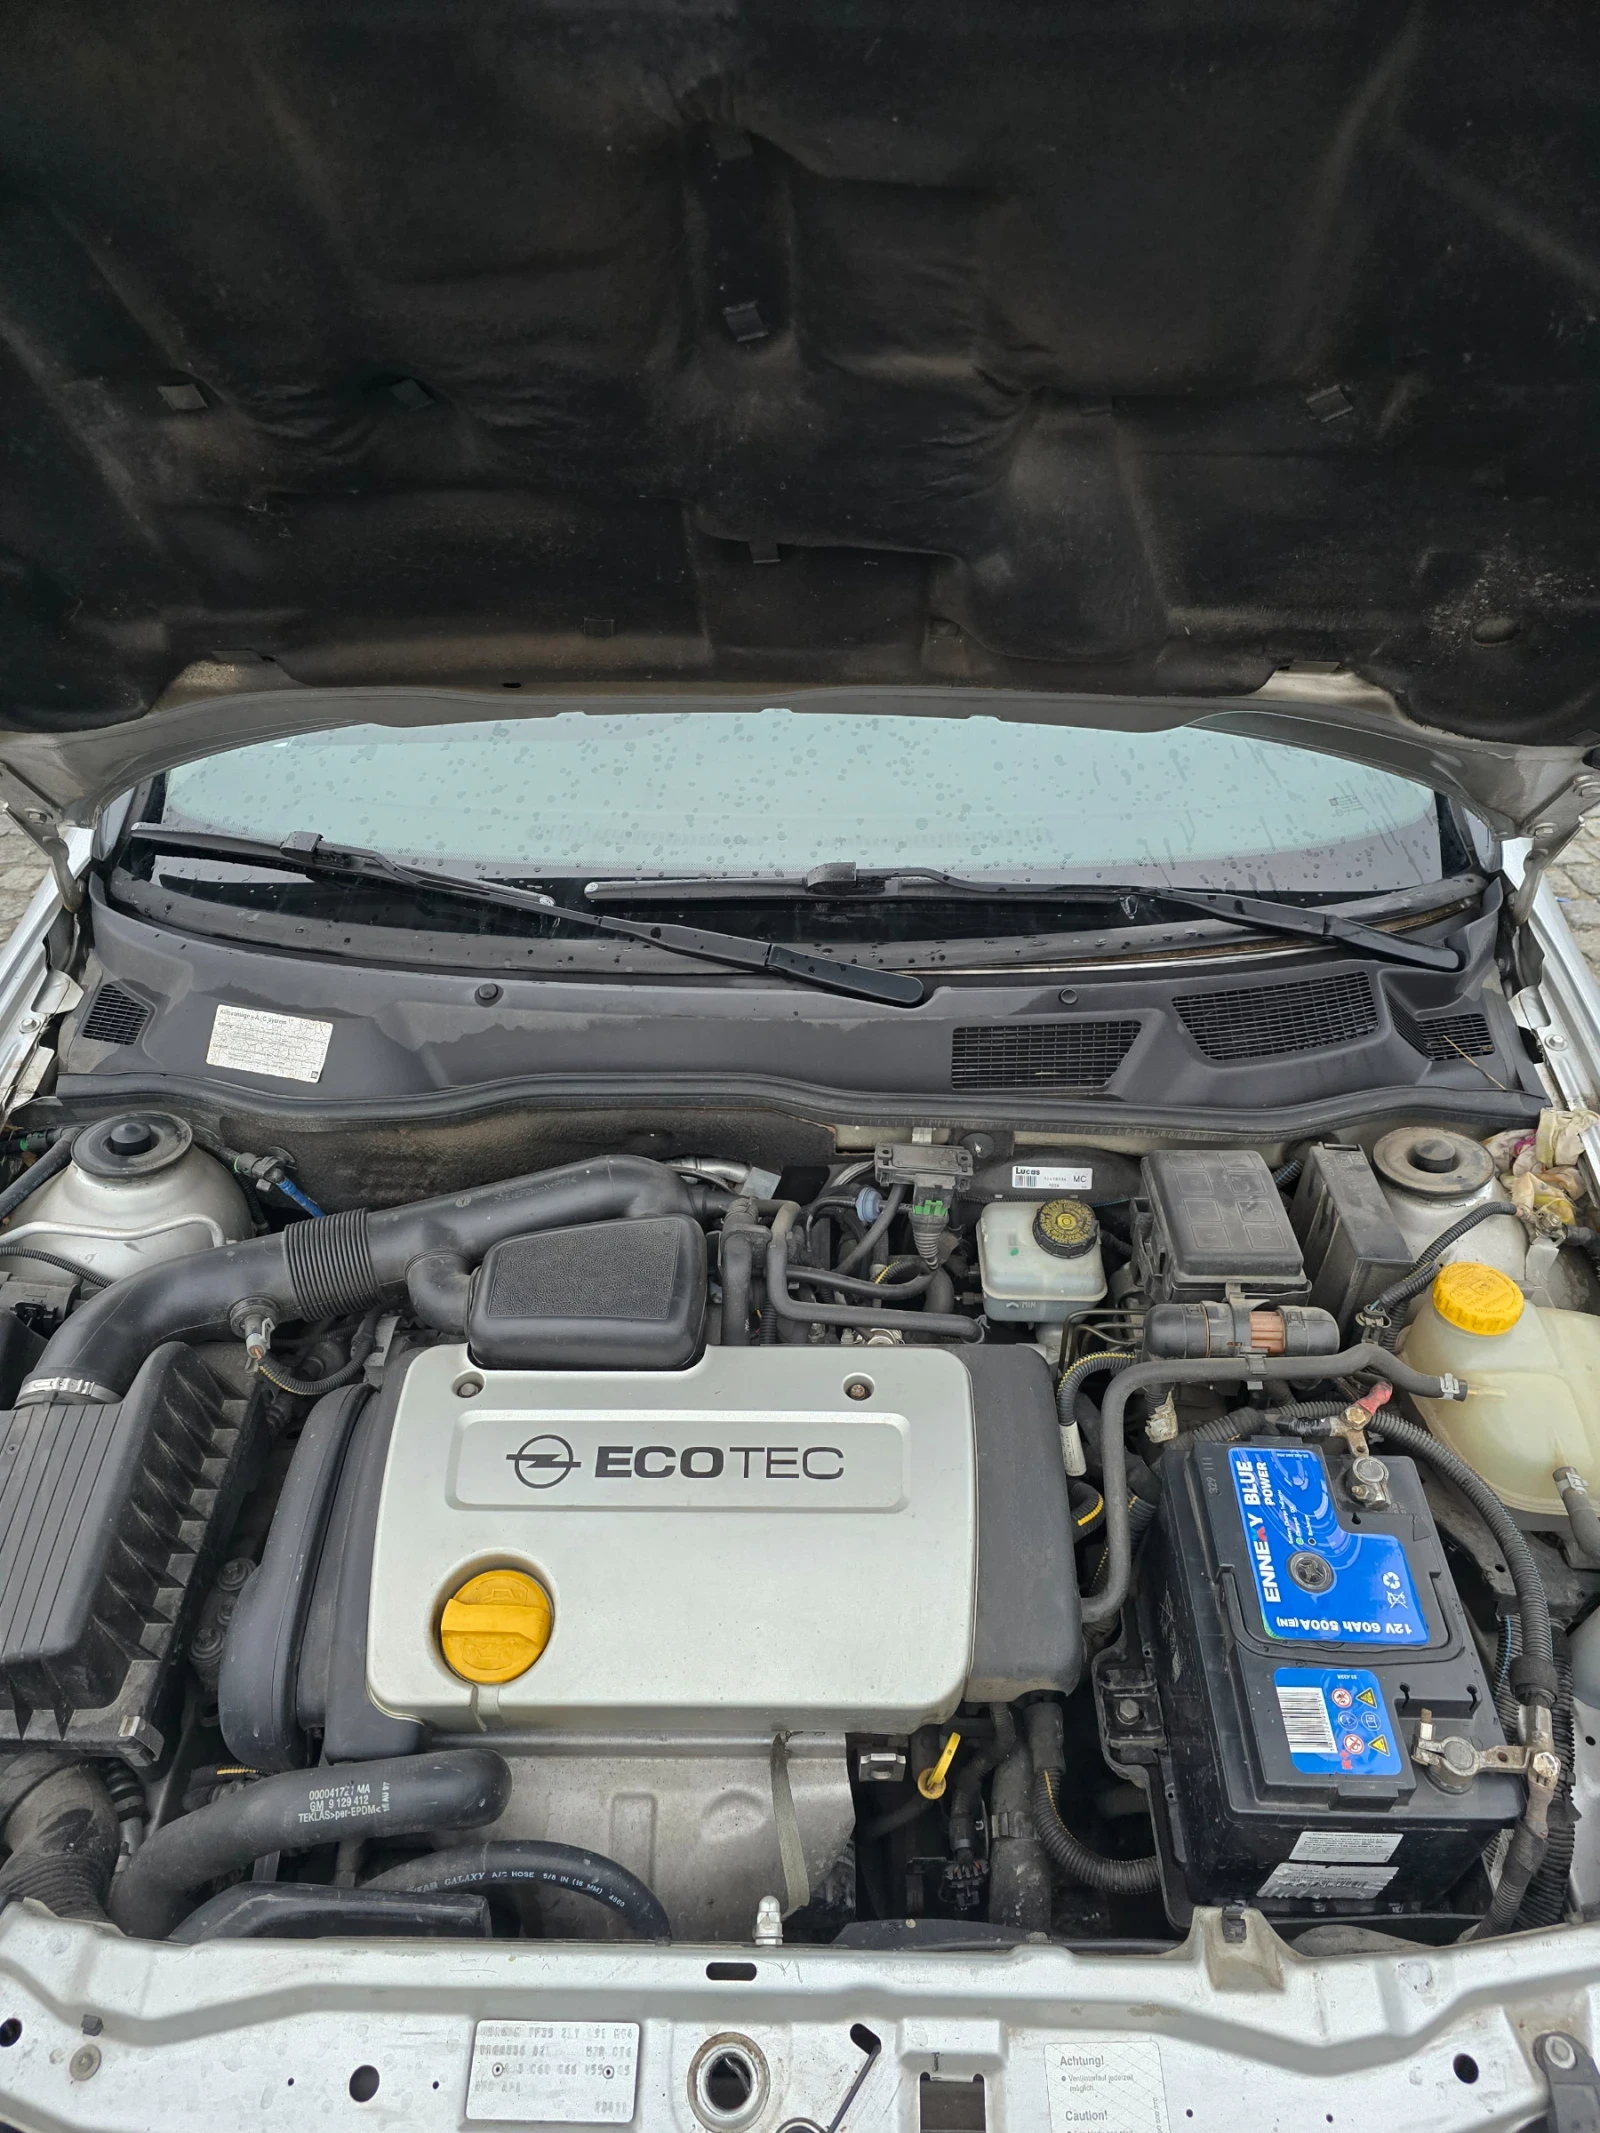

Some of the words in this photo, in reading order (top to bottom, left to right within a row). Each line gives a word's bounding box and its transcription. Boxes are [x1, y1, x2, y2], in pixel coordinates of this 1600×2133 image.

[1015, 1167, 1041, 1175] Lucas
[1073, 1175, 1087, 1183] MC
[1021, 1301, 1036, 1309] MIN
[594, 1445, 845, 1480] ECOTEC
[1236, 1460, 1261, 1506] BLUE
[1256, 1461, 1276, 1507] POWER
[1343, 1621, 1381, 1633] 60Ah
[1385, 1622, 1413, 1635] 12V
[309, 1800, 324, 1812] GM
[328, 1799, 334, 1809] 9
[336, 1797, 352, 1808] 129
[353, 1795, 369, 1805] 412
[444, 1871, 485, 1886] GALAXY
[511, 1870, 535, 1878] HOSE
[560, 1875, 569, 1884] IN
[586, 1883, 603, 1895] MM)
[1060, 2055, 1104, 2068] Achtung!
[1065, 2109, 1108, 2121] Caution!
